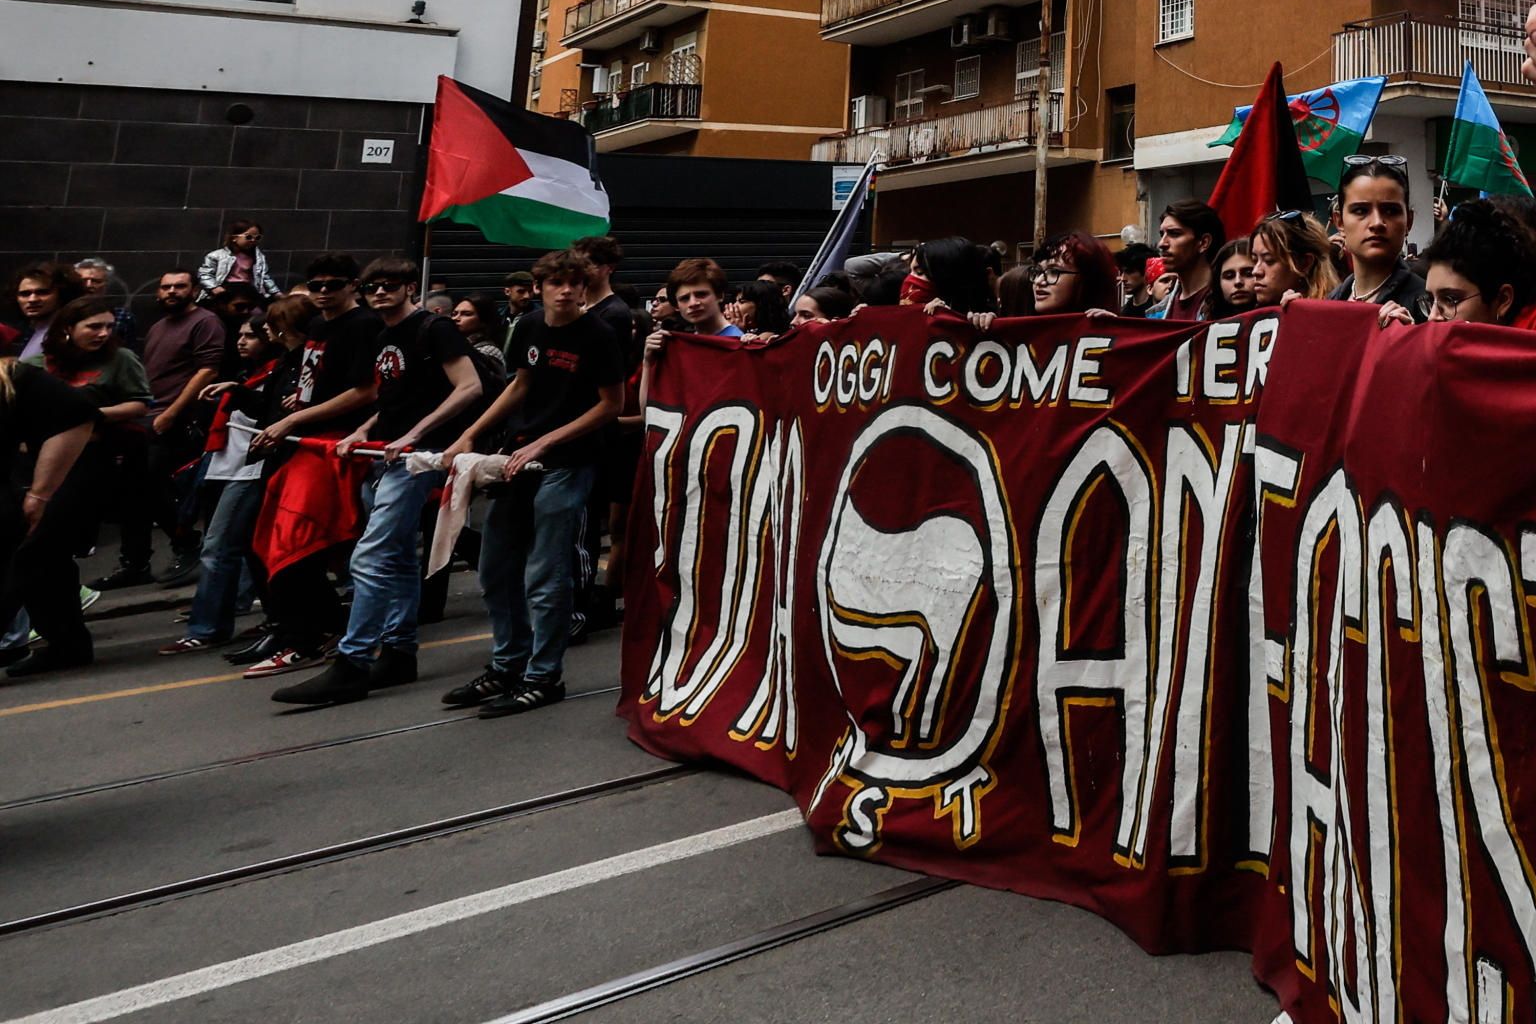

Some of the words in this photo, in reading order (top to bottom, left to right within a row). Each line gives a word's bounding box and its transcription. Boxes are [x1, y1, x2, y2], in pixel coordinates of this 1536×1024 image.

[366, 146, 391, 157] 207
[813, 337, 897, 404] OGGI
[923, 336, 1113, 403] COME
[1175, 316, 1280, 400] IER
